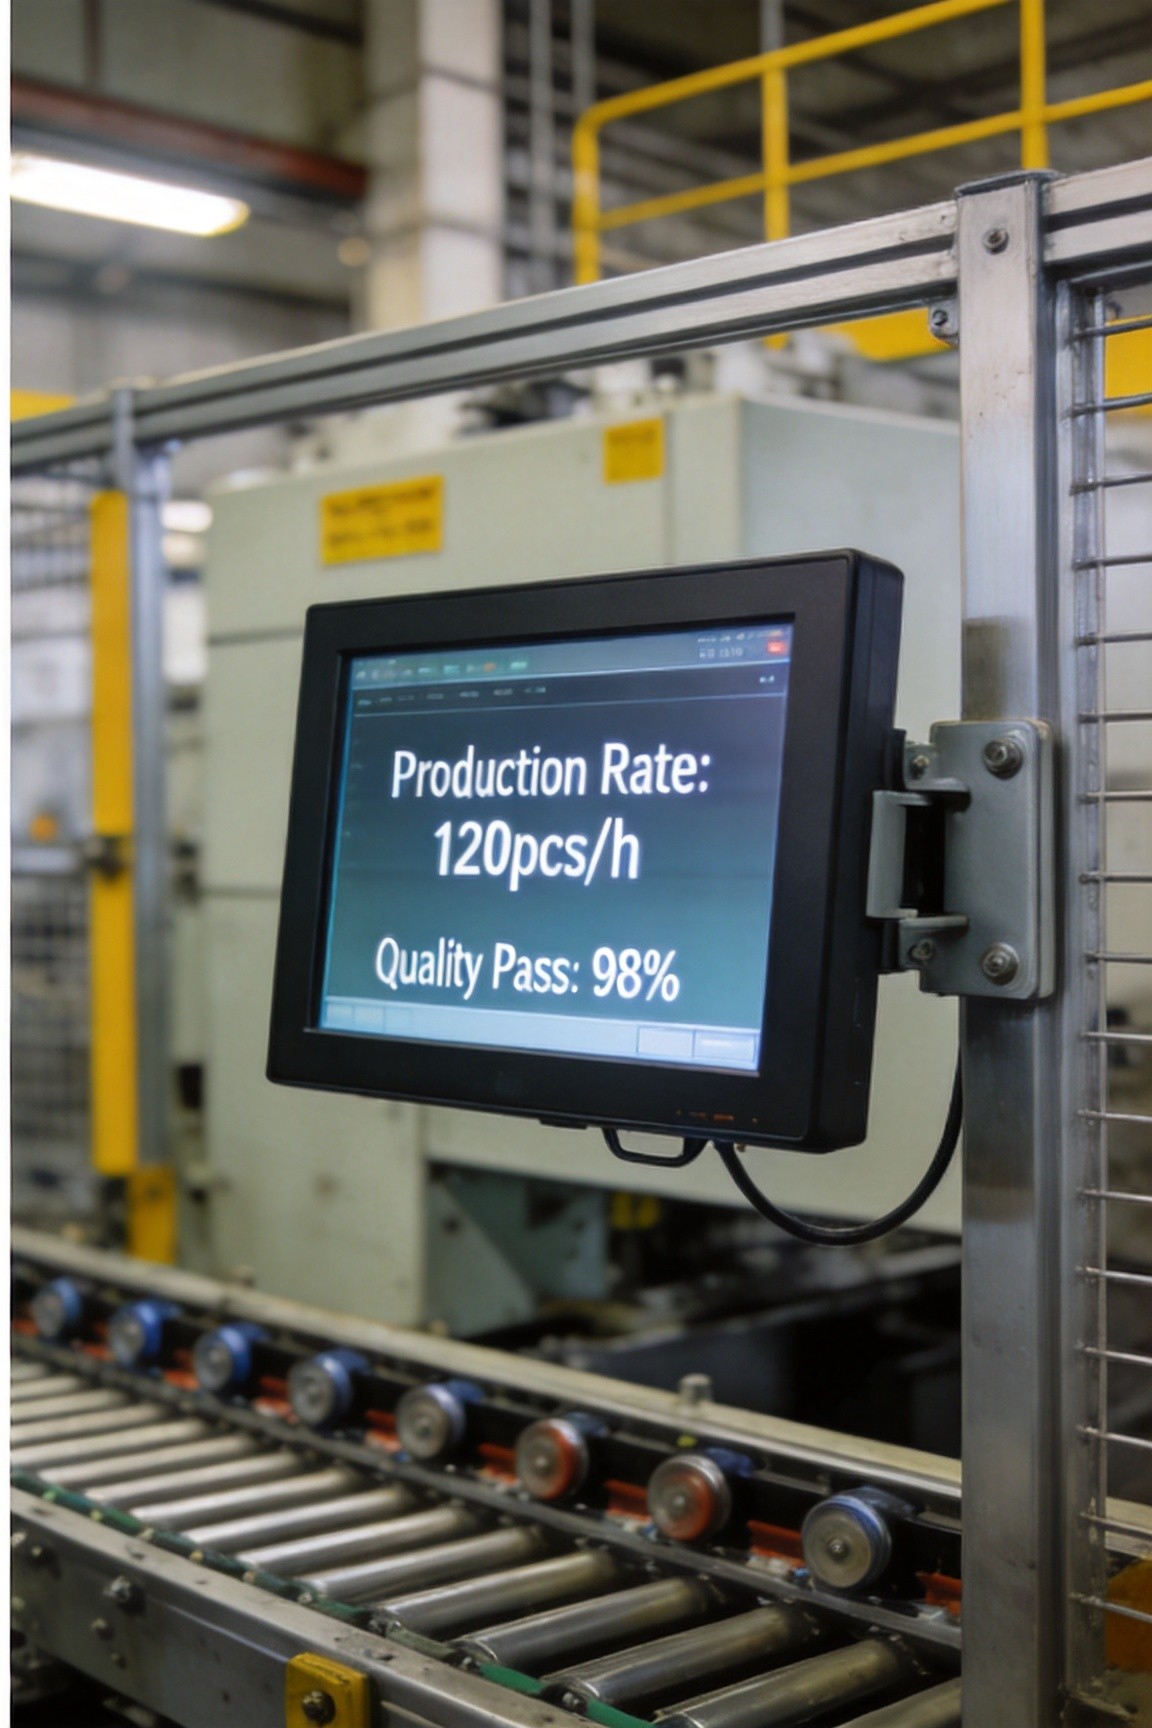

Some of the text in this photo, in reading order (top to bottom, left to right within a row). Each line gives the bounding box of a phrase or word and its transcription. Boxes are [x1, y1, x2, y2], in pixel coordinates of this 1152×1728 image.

[391, 743, 711, 797] Production Rate:
[435, 817, 640, 892] 120pcs/h
[375, 937, 681, 1003] Quality Pass: 98%
